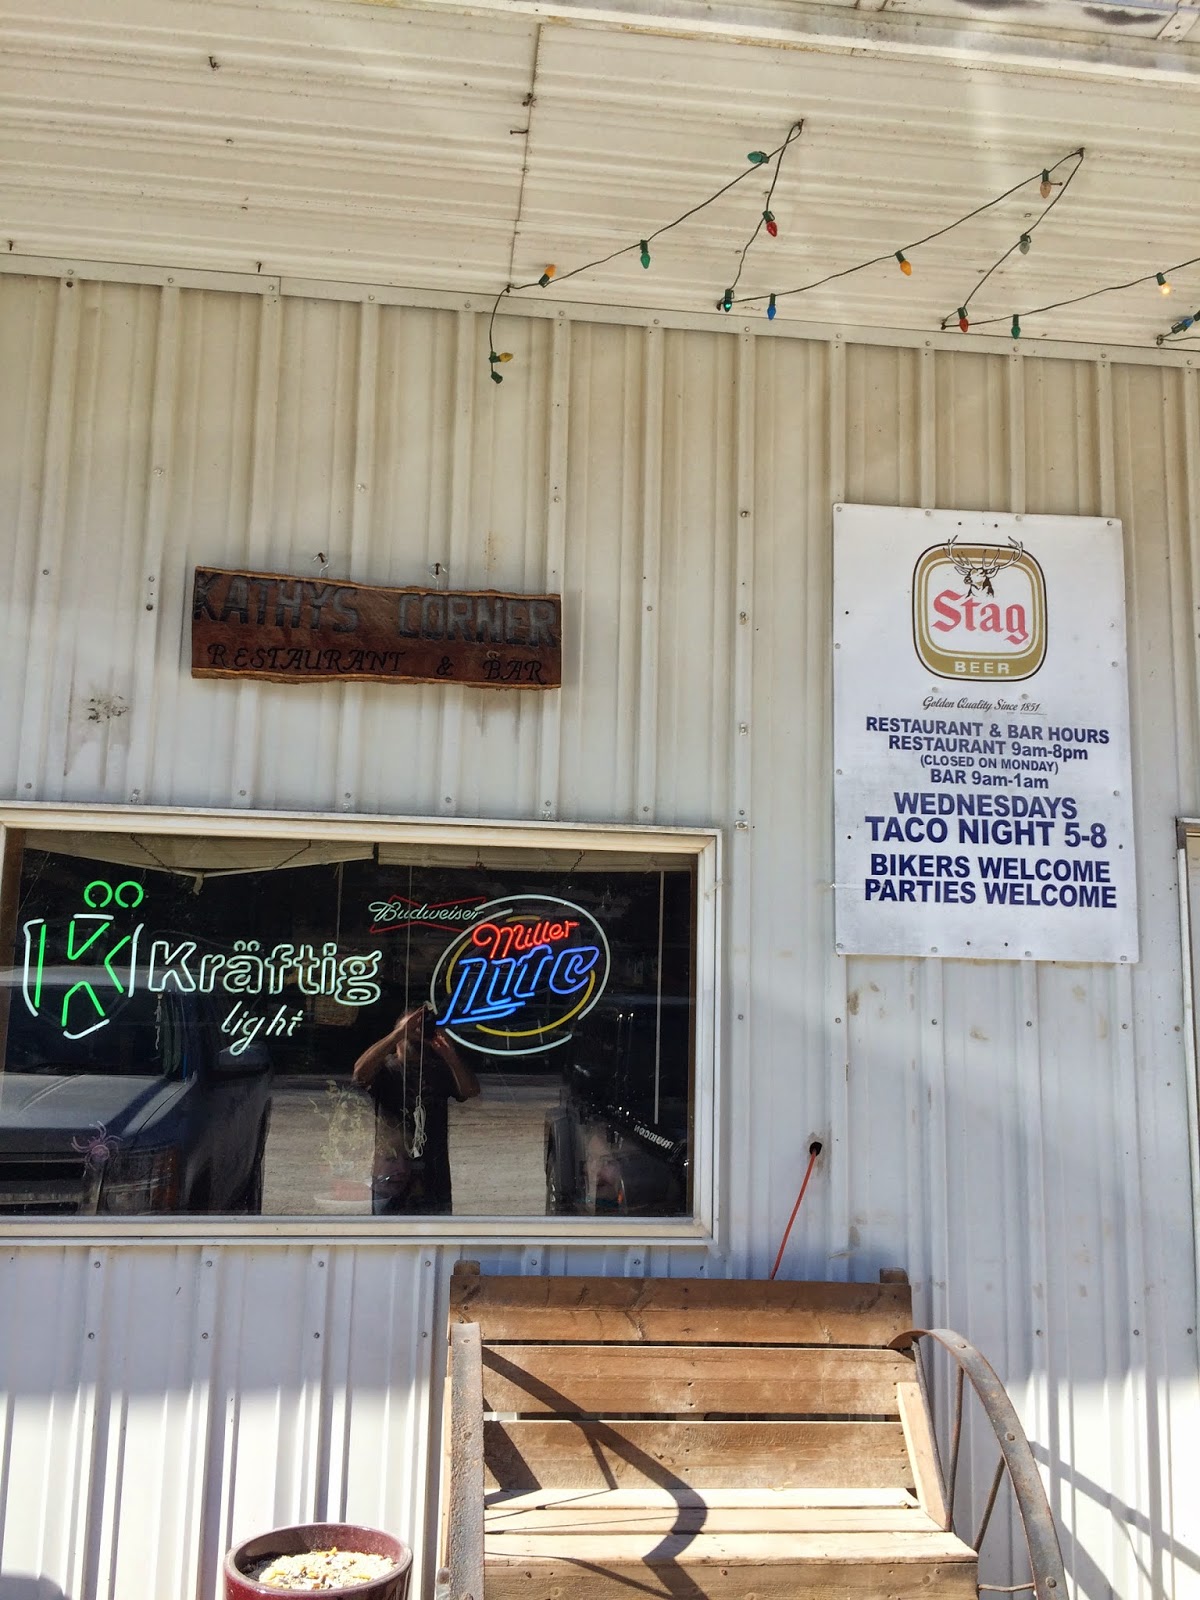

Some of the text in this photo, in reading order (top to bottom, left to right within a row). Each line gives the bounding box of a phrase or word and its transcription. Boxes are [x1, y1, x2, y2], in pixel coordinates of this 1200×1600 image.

[194, 571, 557, 648] KATHYS CORNER
[931, 589, 1029, 645] Stag
[207, 644, 546, 685] RESTAURANT & BAR
[954, 661, 1010, 674] BEER
[923, 696, 1040, 713] Golden Quality Since 1851
[866, 716, 1110, 744] RESTAURANT & BAR HOURS
[889, 735, 1088, 762] RESTAURANT 9am-8pm
[920, 755, 1059, 775] (CLOSED ON MONDAY)
[930, 769, 1049, 789] BAR 9am-1am
[894, 792, 1077, 819] WEDNESDAYS
[865, 816, 1107, 848] TACO NIGHT 5-8
[871, 854, 1111, 883] BIKERS WELCOME
[865, 879, 1117, 908] PARTIES WELCOME
[368, 900, 484, 922] Budweiser
[472, 920, 580, 960] Miller
[148, 940, 383, 1005] Kräftig
[220, 1000, 303, 1057] light
